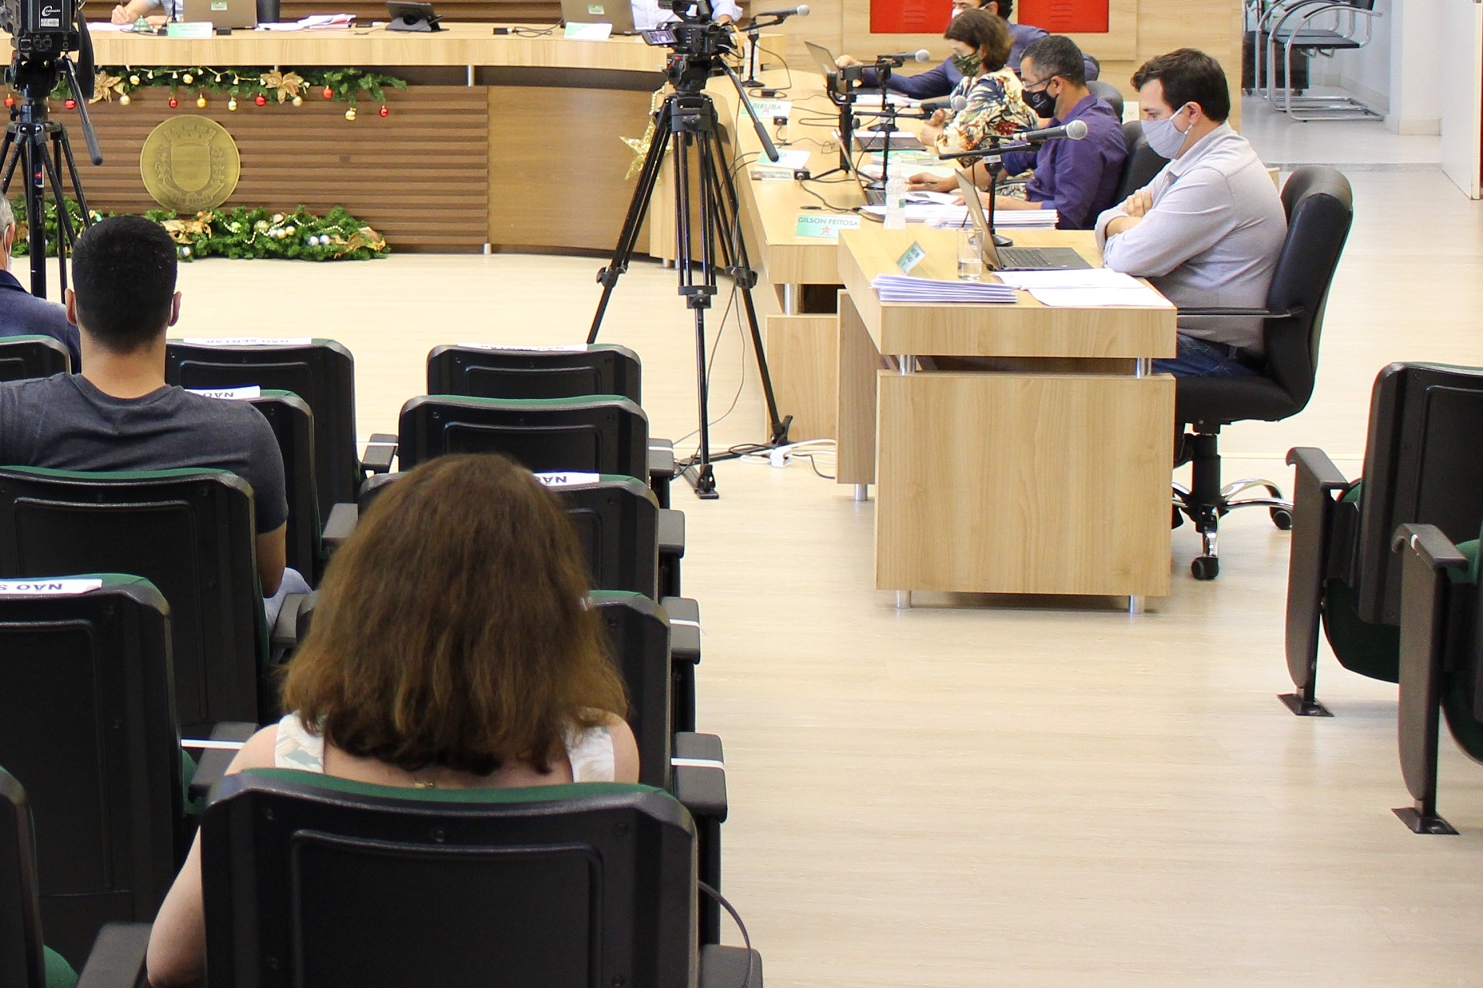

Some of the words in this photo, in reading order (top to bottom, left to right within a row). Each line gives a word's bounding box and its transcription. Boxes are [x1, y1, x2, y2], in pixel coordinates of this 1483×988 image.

[798, 216, 826, 224] GILSON
[828, 218, 858, 226] FEITOSA
[16, 583, 64, 593] NÃO
